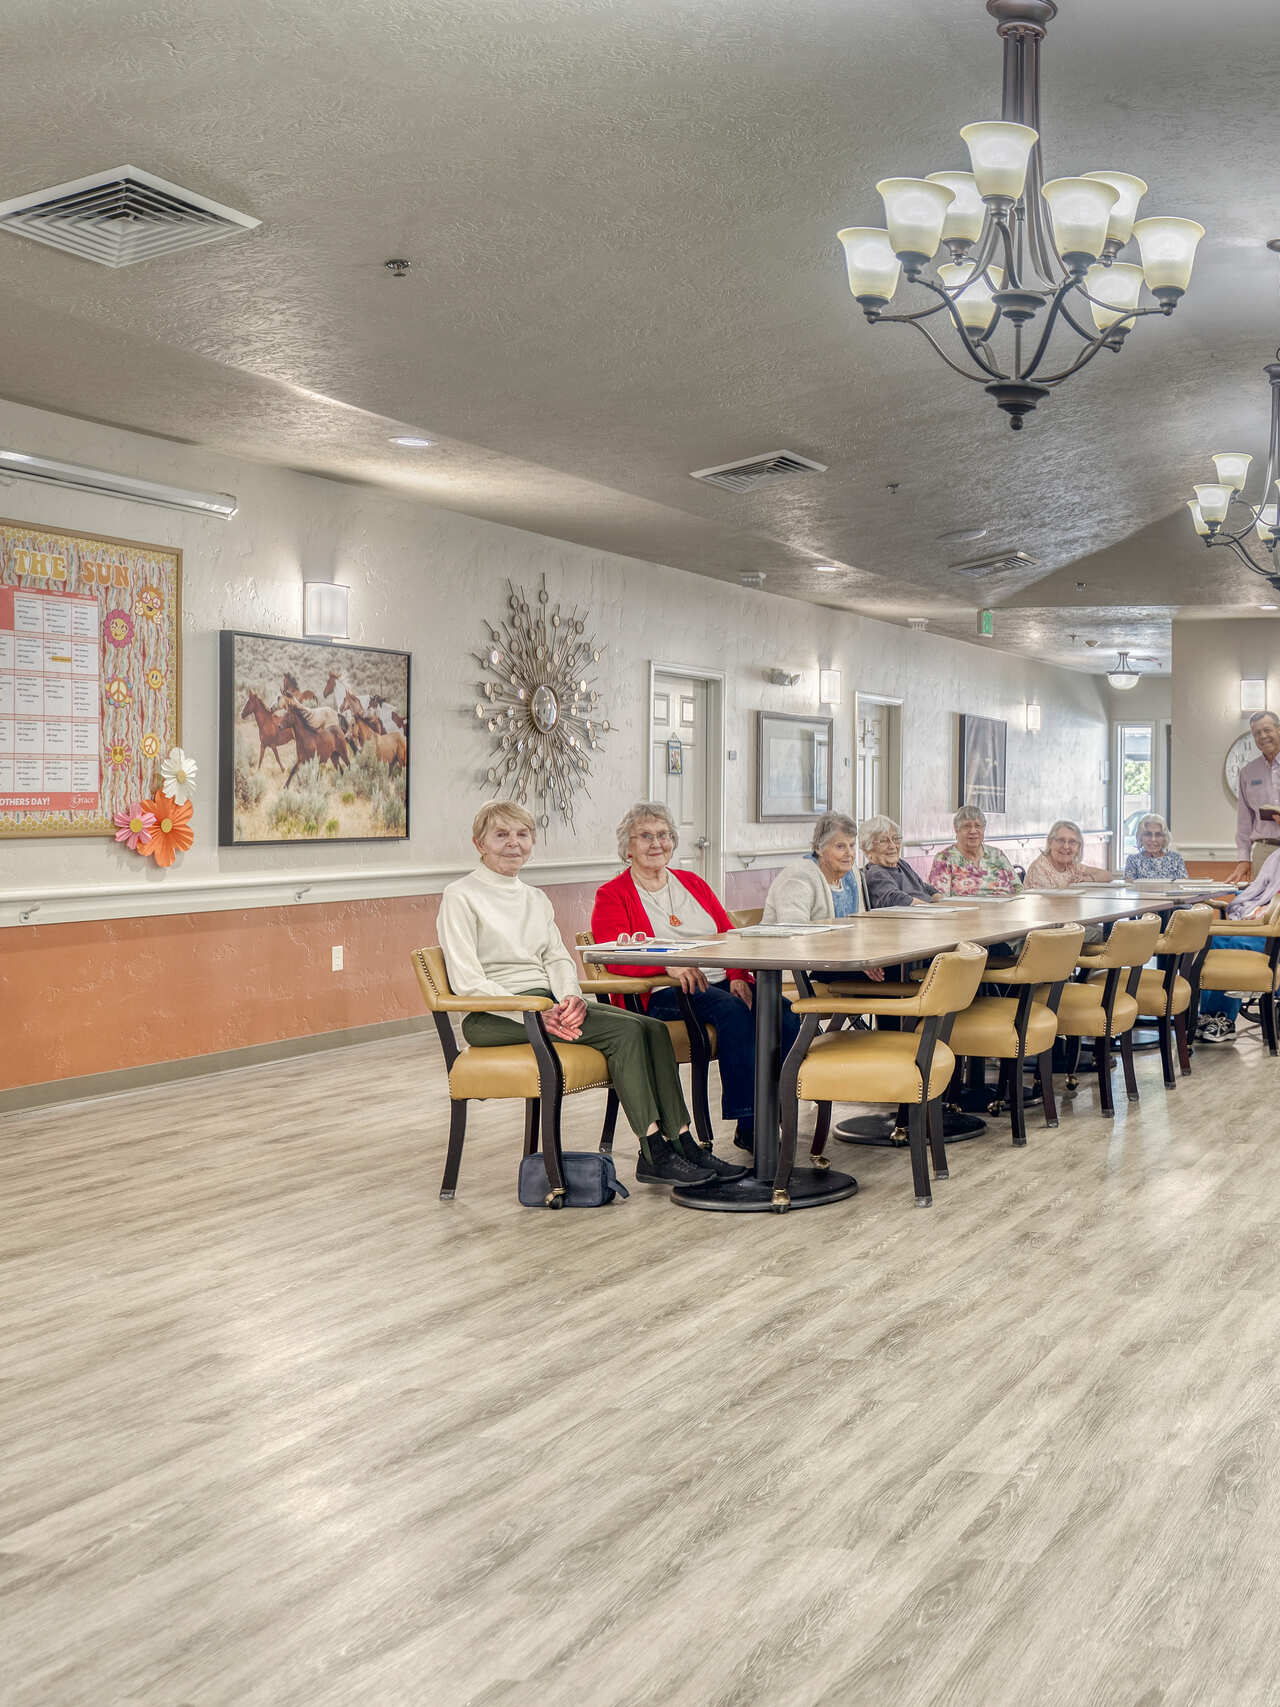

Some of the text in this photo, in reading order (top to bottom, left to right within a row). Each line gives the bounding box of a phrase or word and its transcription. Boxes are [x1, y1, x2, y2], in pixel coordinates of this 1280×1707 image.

[14, 548, 130, 588] THE SUN
[32, 796, 50, 806] DAY!
